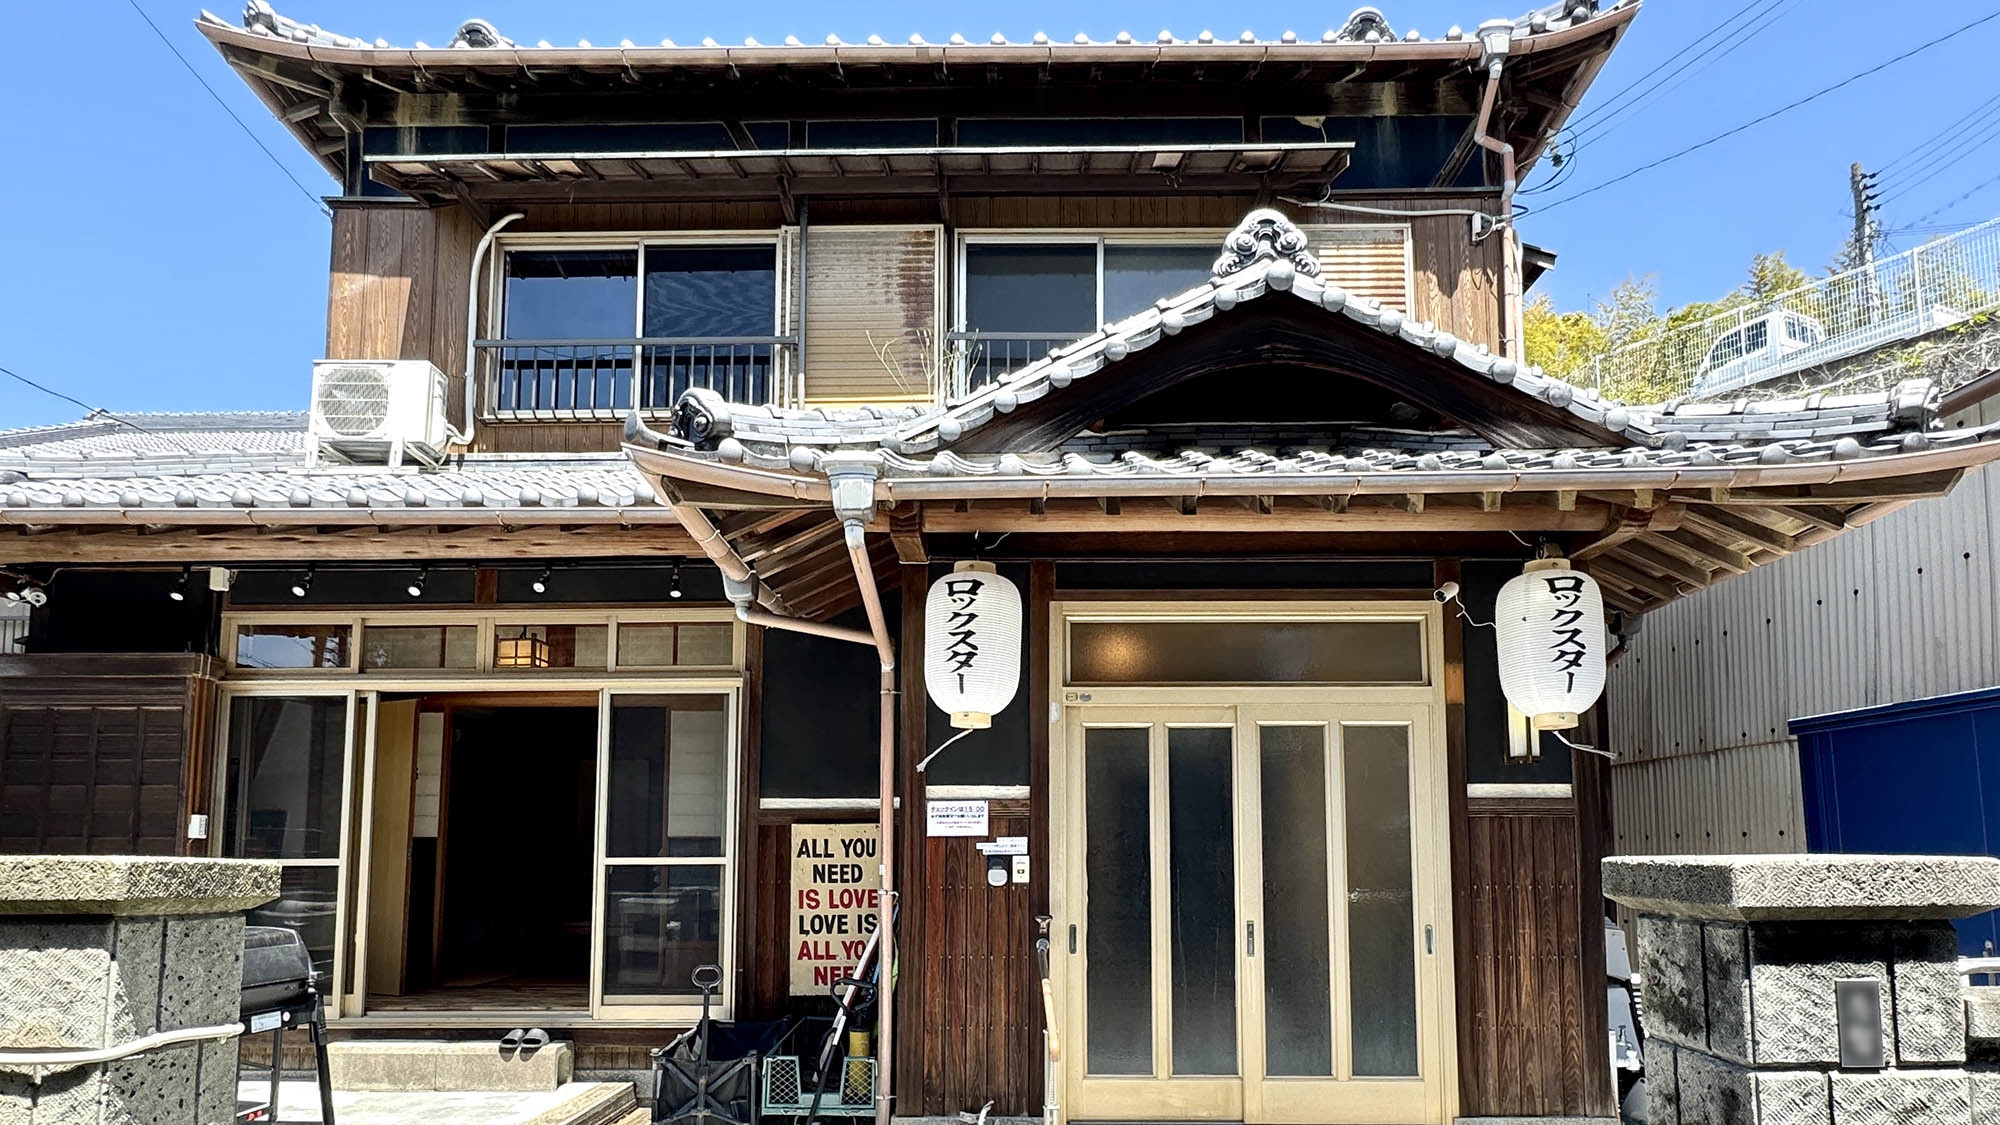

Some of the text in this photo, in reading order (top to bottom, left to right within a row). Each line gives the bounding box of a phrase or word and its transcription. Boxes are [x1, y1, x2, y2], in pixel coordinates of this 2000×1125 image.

[944, 578, 985, 695] ロックスター
[1542, 575, 1587, 694] ロックスター
[796, 837, 877, 859] ALL YOU
[812, 863, 863, 884] NEED
[798, 888, 878, 910] IS LOVE
[798, 913, 878, 934] LOVE IS
[797, 940, 869, 961] ALL YO
[814, 966, 858, 986] NEE
